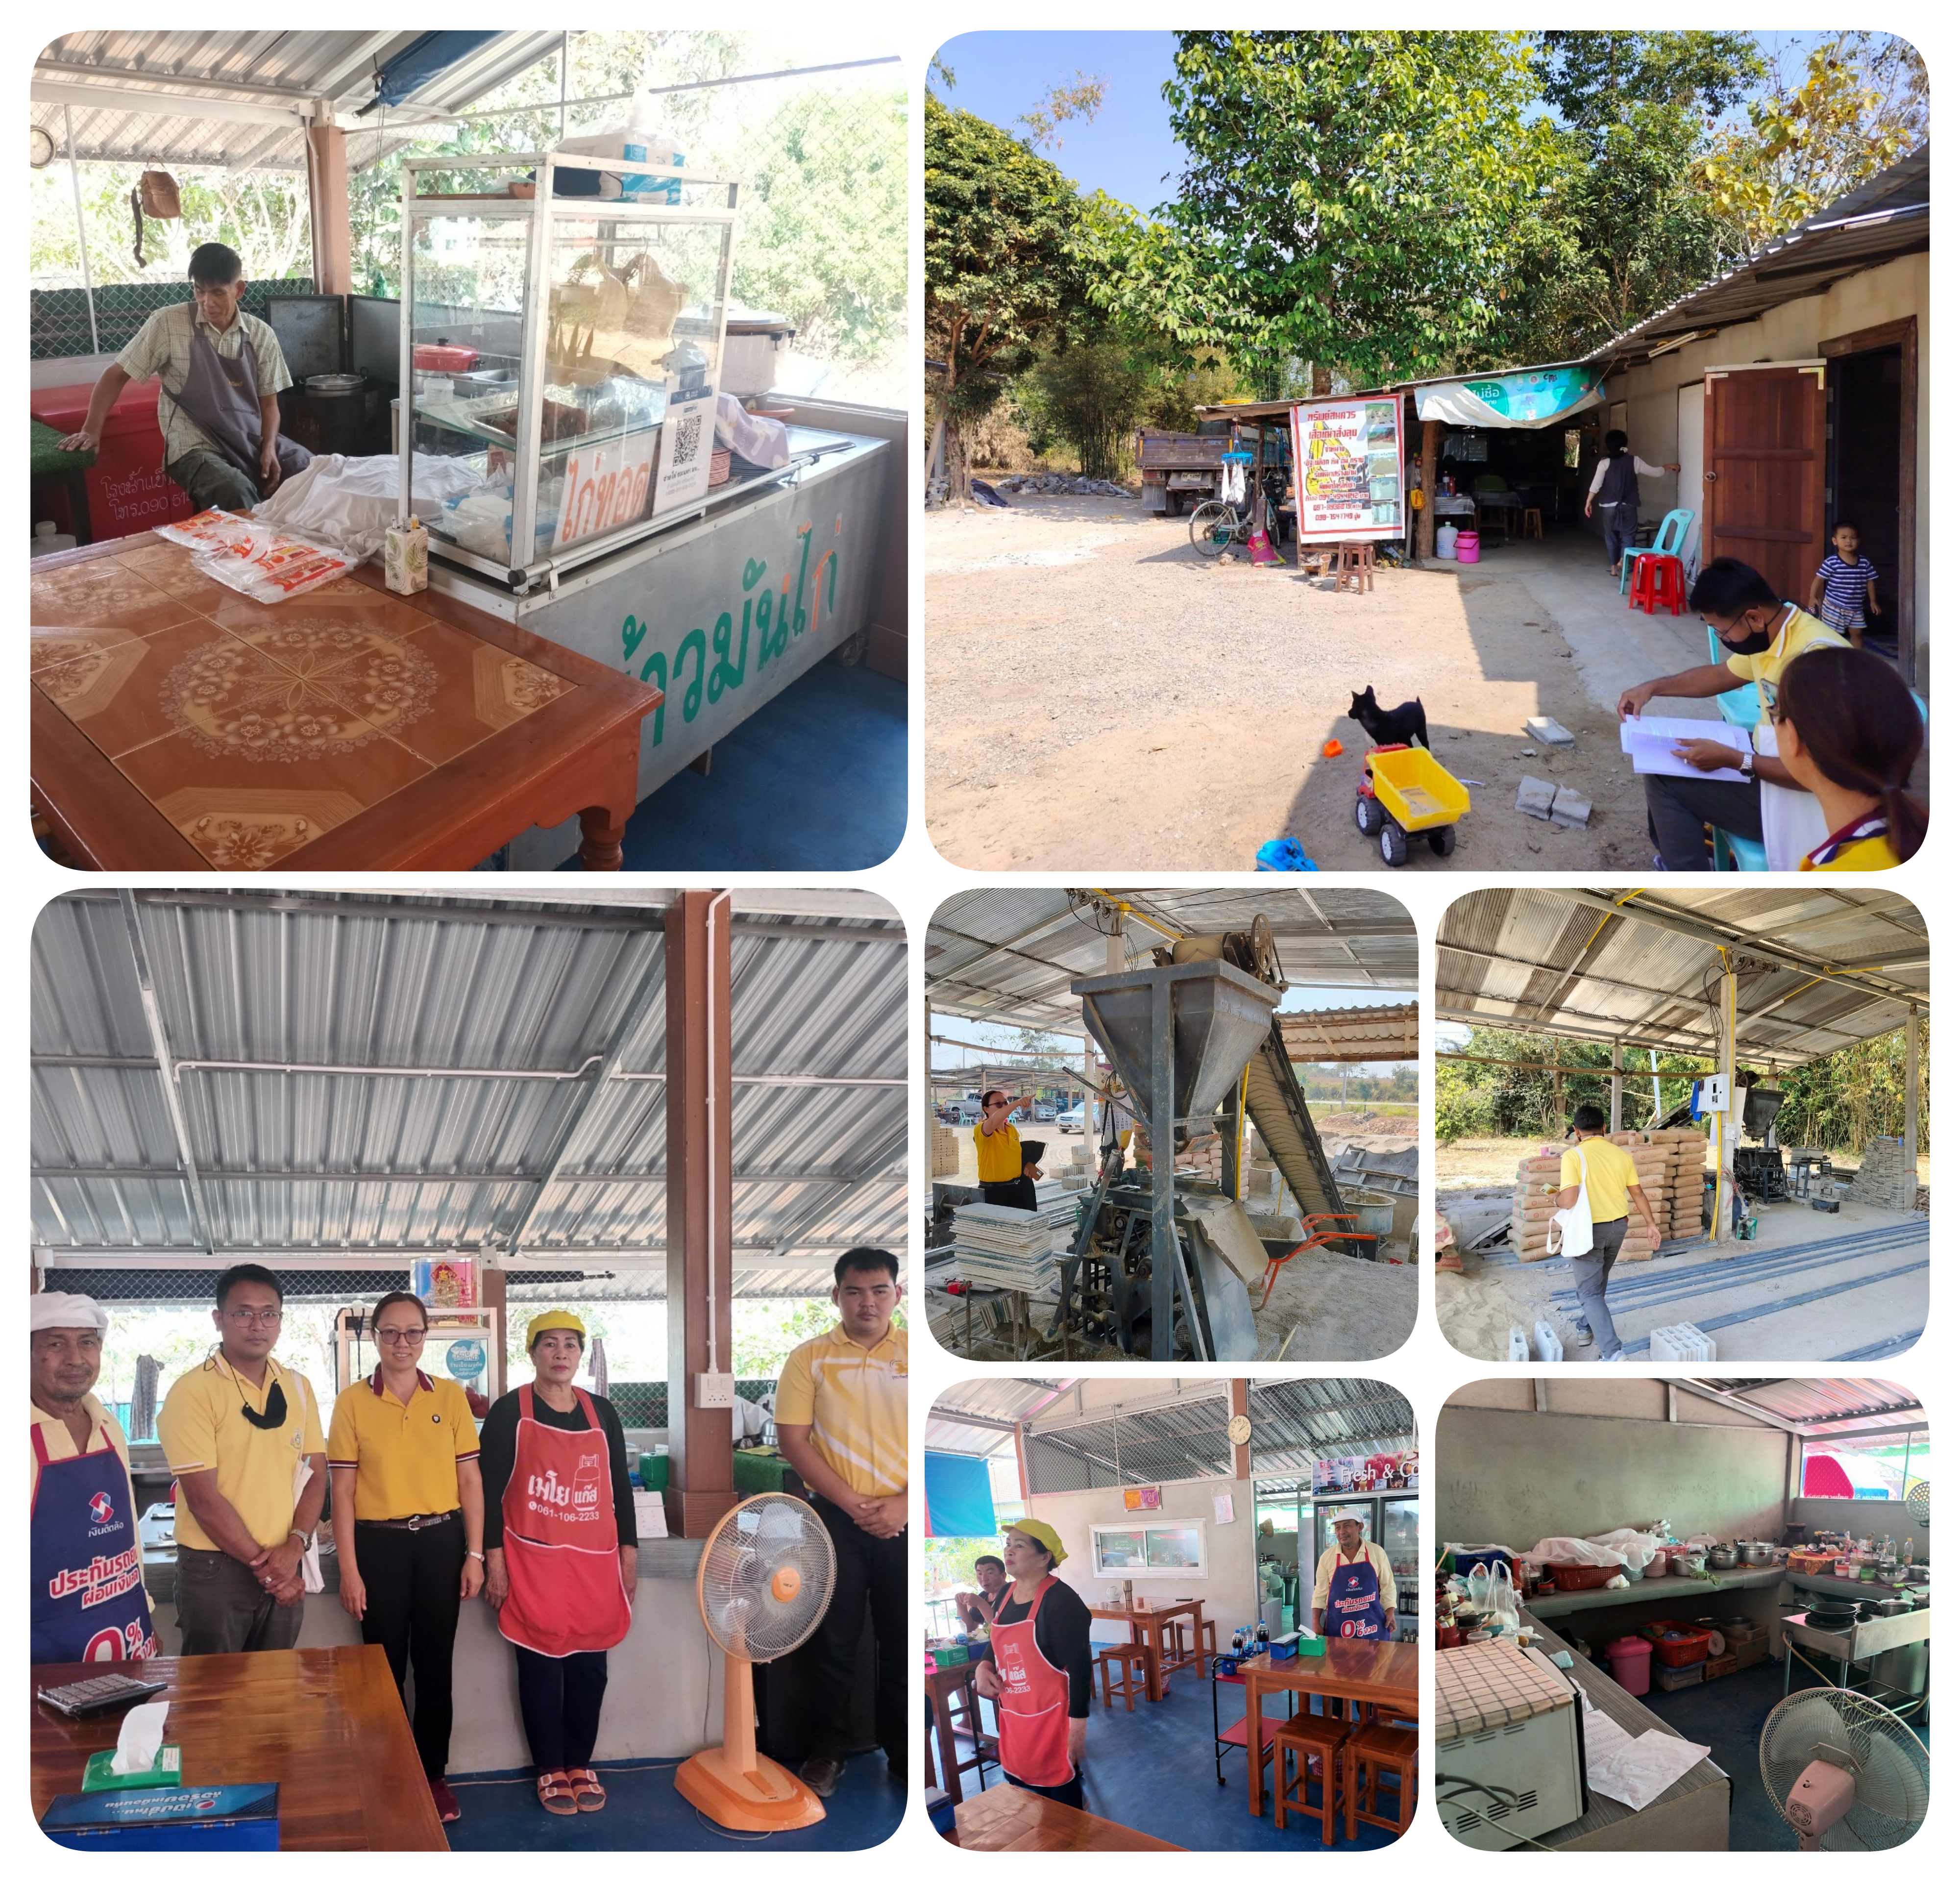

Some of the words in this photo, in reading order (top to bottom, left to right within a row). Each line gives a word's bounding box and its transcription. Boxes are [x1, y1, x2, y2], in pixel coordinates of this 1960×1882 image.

[561, 452, 650, 543] ไก่ทอด
[621, 513, 843, 747] ้าวมันไก่
[1341, 1463, 1376, 1484] Fresh
[1382, 1463, 1395, 1480] &
[528, 1470, 570, 1507] เมโย
[574, 1484, 597, 1505] แก๊ส
[537, 1504, 599, 1522] 061-106-2233
[88, 1520, 124, 1537] เงินติดล้อ
[1335, 1592, 1376, 1608] ประกันรถยนต์
[1342, 1603, 1370, 1613] ผ่อนเงินสด
